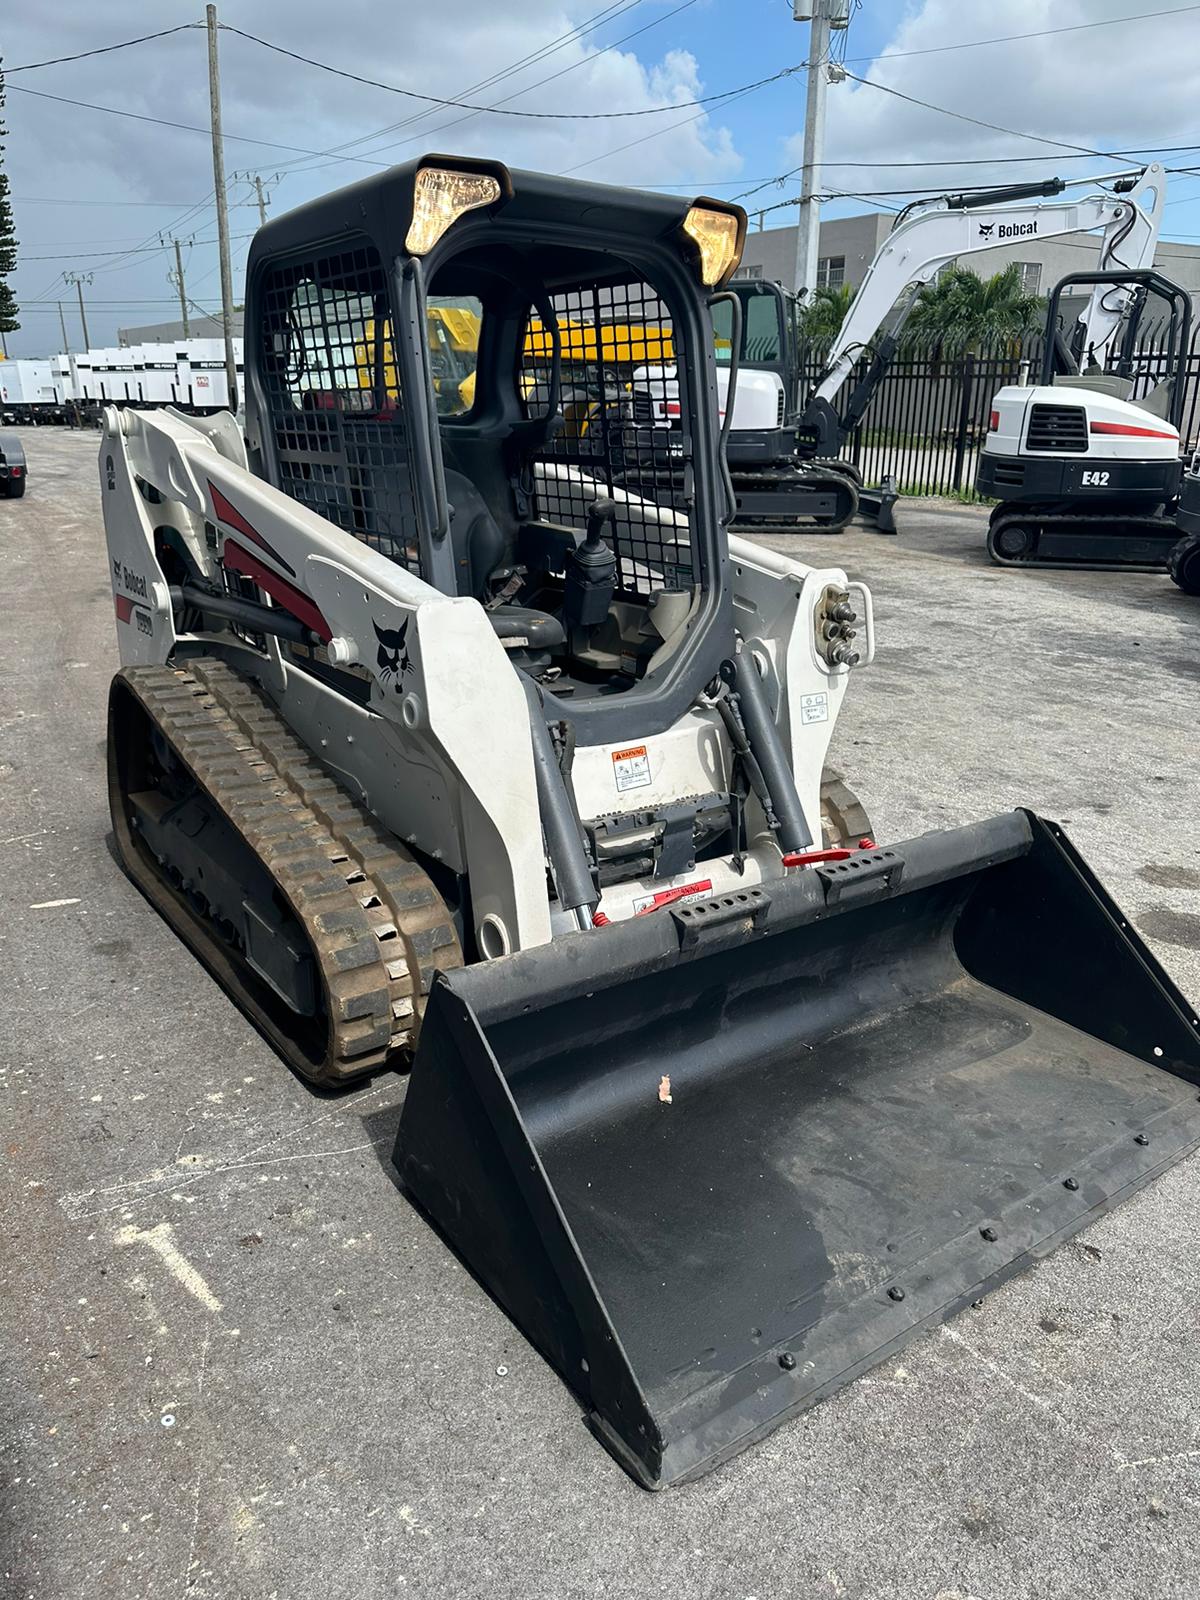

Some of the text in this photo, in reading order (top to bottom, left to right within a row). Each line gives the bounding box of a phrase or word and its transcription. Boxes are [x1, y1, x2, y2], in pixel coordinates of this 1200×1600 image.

[998, 220, 1037, 238] Bobcat
[1082, 471, 1110, 486] E42
[123, 566, 148, 599] Bobcat
[620, 748, 644, 758] WARNING
